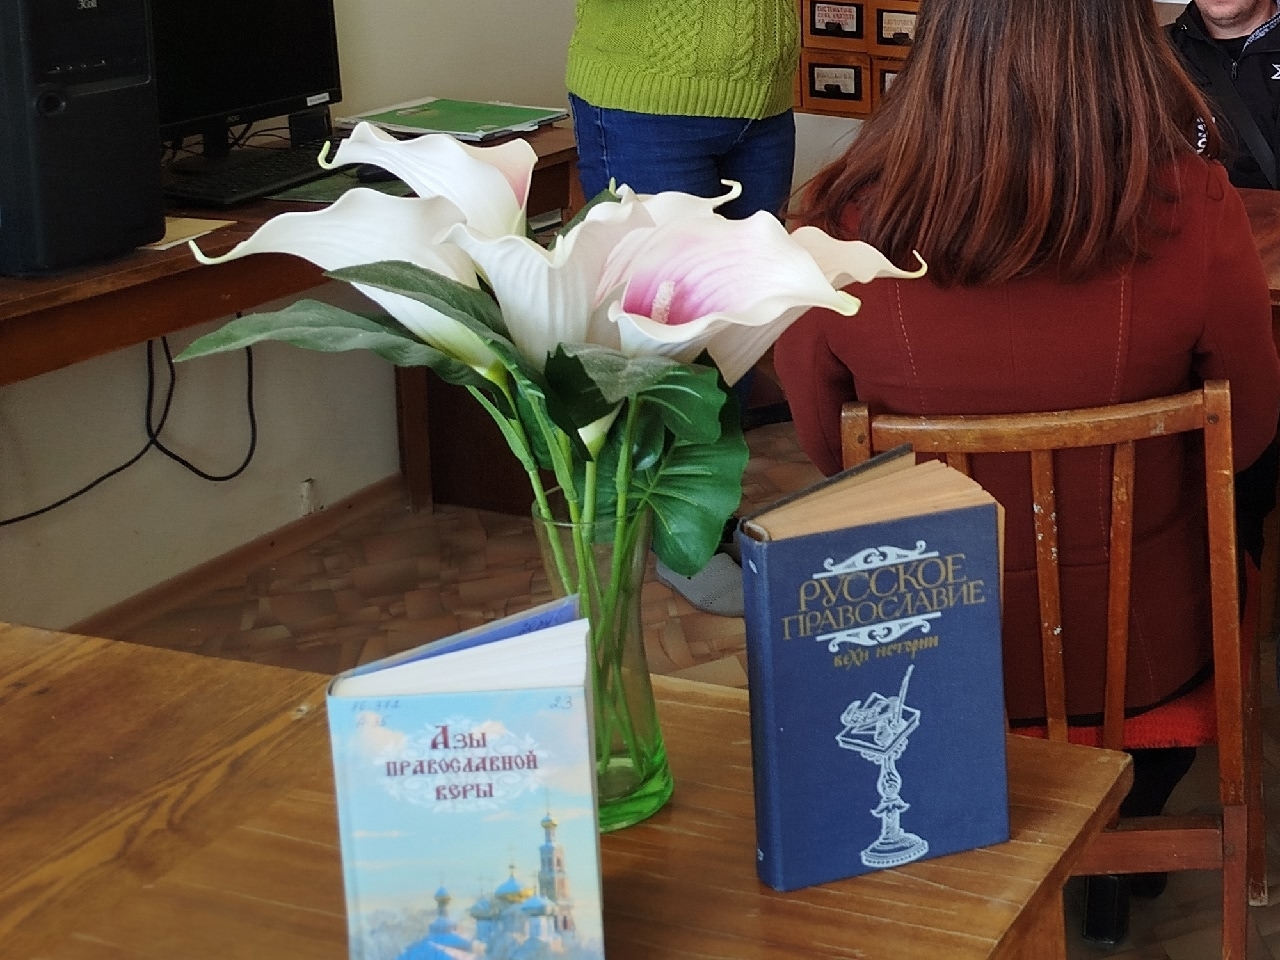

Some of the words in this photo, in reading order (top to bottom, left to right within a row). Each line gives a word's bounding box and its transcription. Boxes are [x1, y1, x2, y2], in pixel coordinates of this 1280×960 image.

[799, 553, 967, 612] РУССКОЕ
[782, 580, 986, 640] ПРАВОСЛАВИЕ
[876, 635, 939, 659] истории
[551, 695, 573, 710] 23
